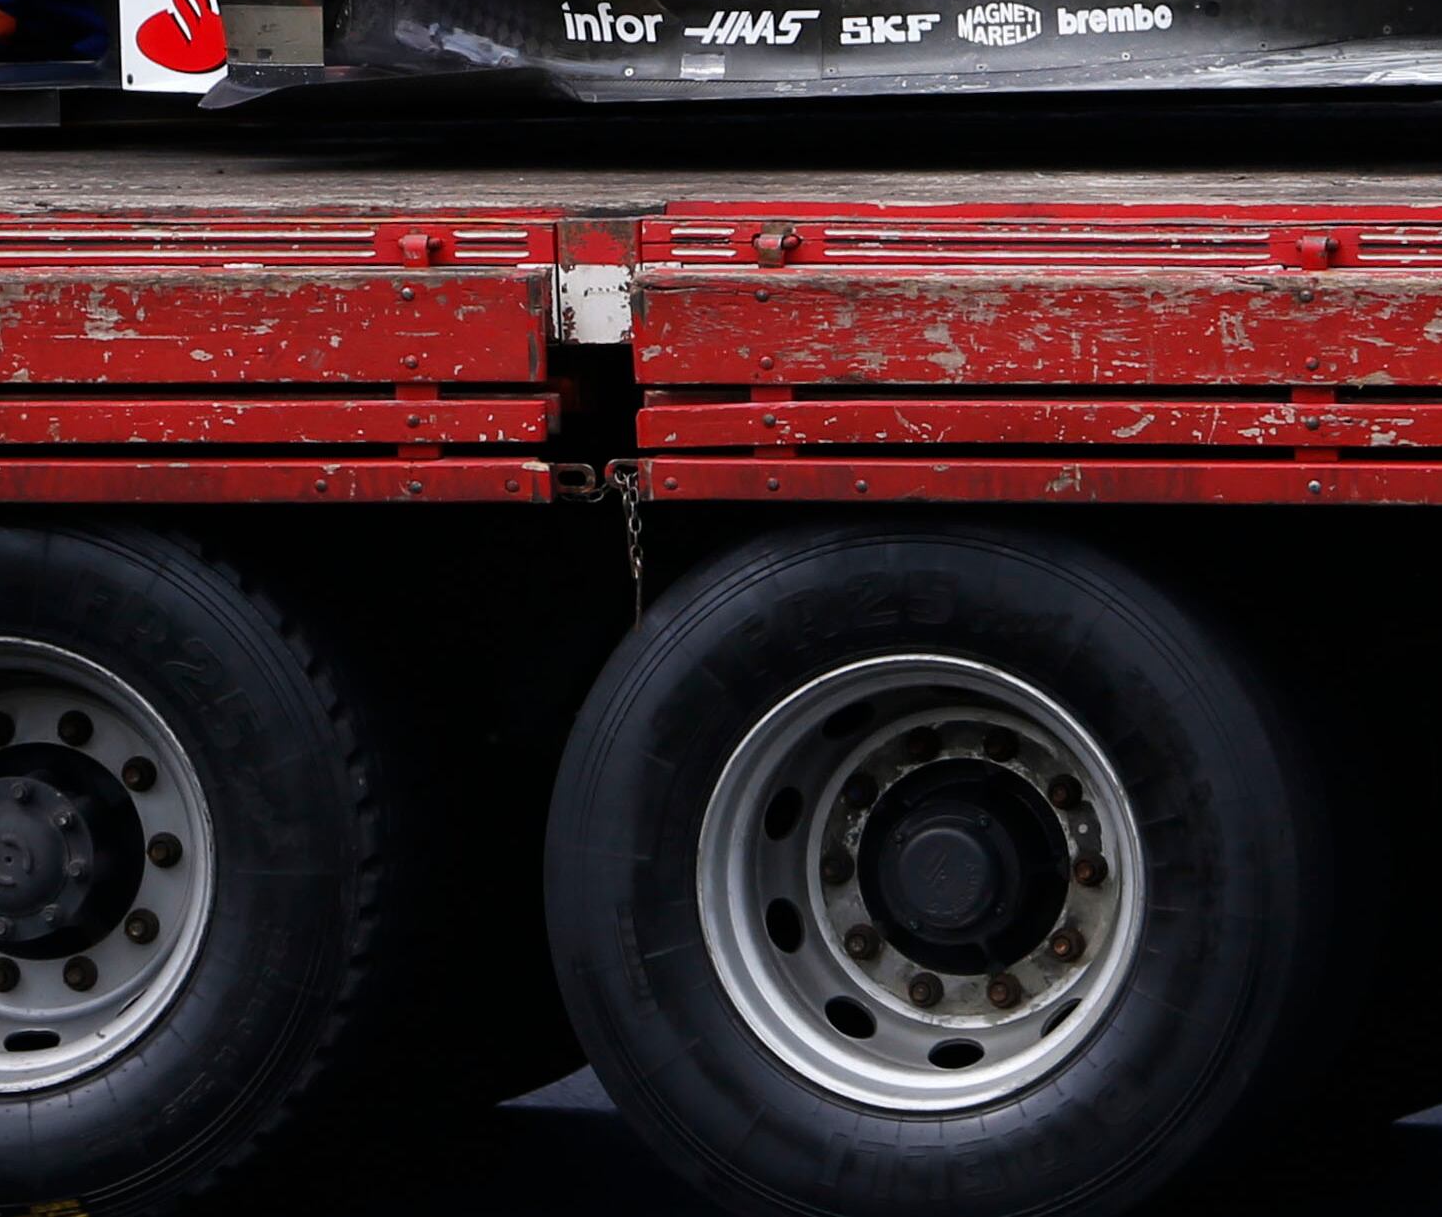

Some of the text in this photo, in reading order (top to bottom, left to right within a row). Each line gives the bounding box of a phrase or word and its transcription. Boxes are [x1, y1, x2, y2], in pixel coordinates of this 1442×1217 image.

[561, 3, 664, 43] infor
[683, 9, 821, 46] HAAS
[839, 13, 941, 45] SKF
[958, 2, 1042, 32] MAGNETI
[958, 20, 1042, 46] MARELLI
[1057, 3, 1173, 36] brembo
